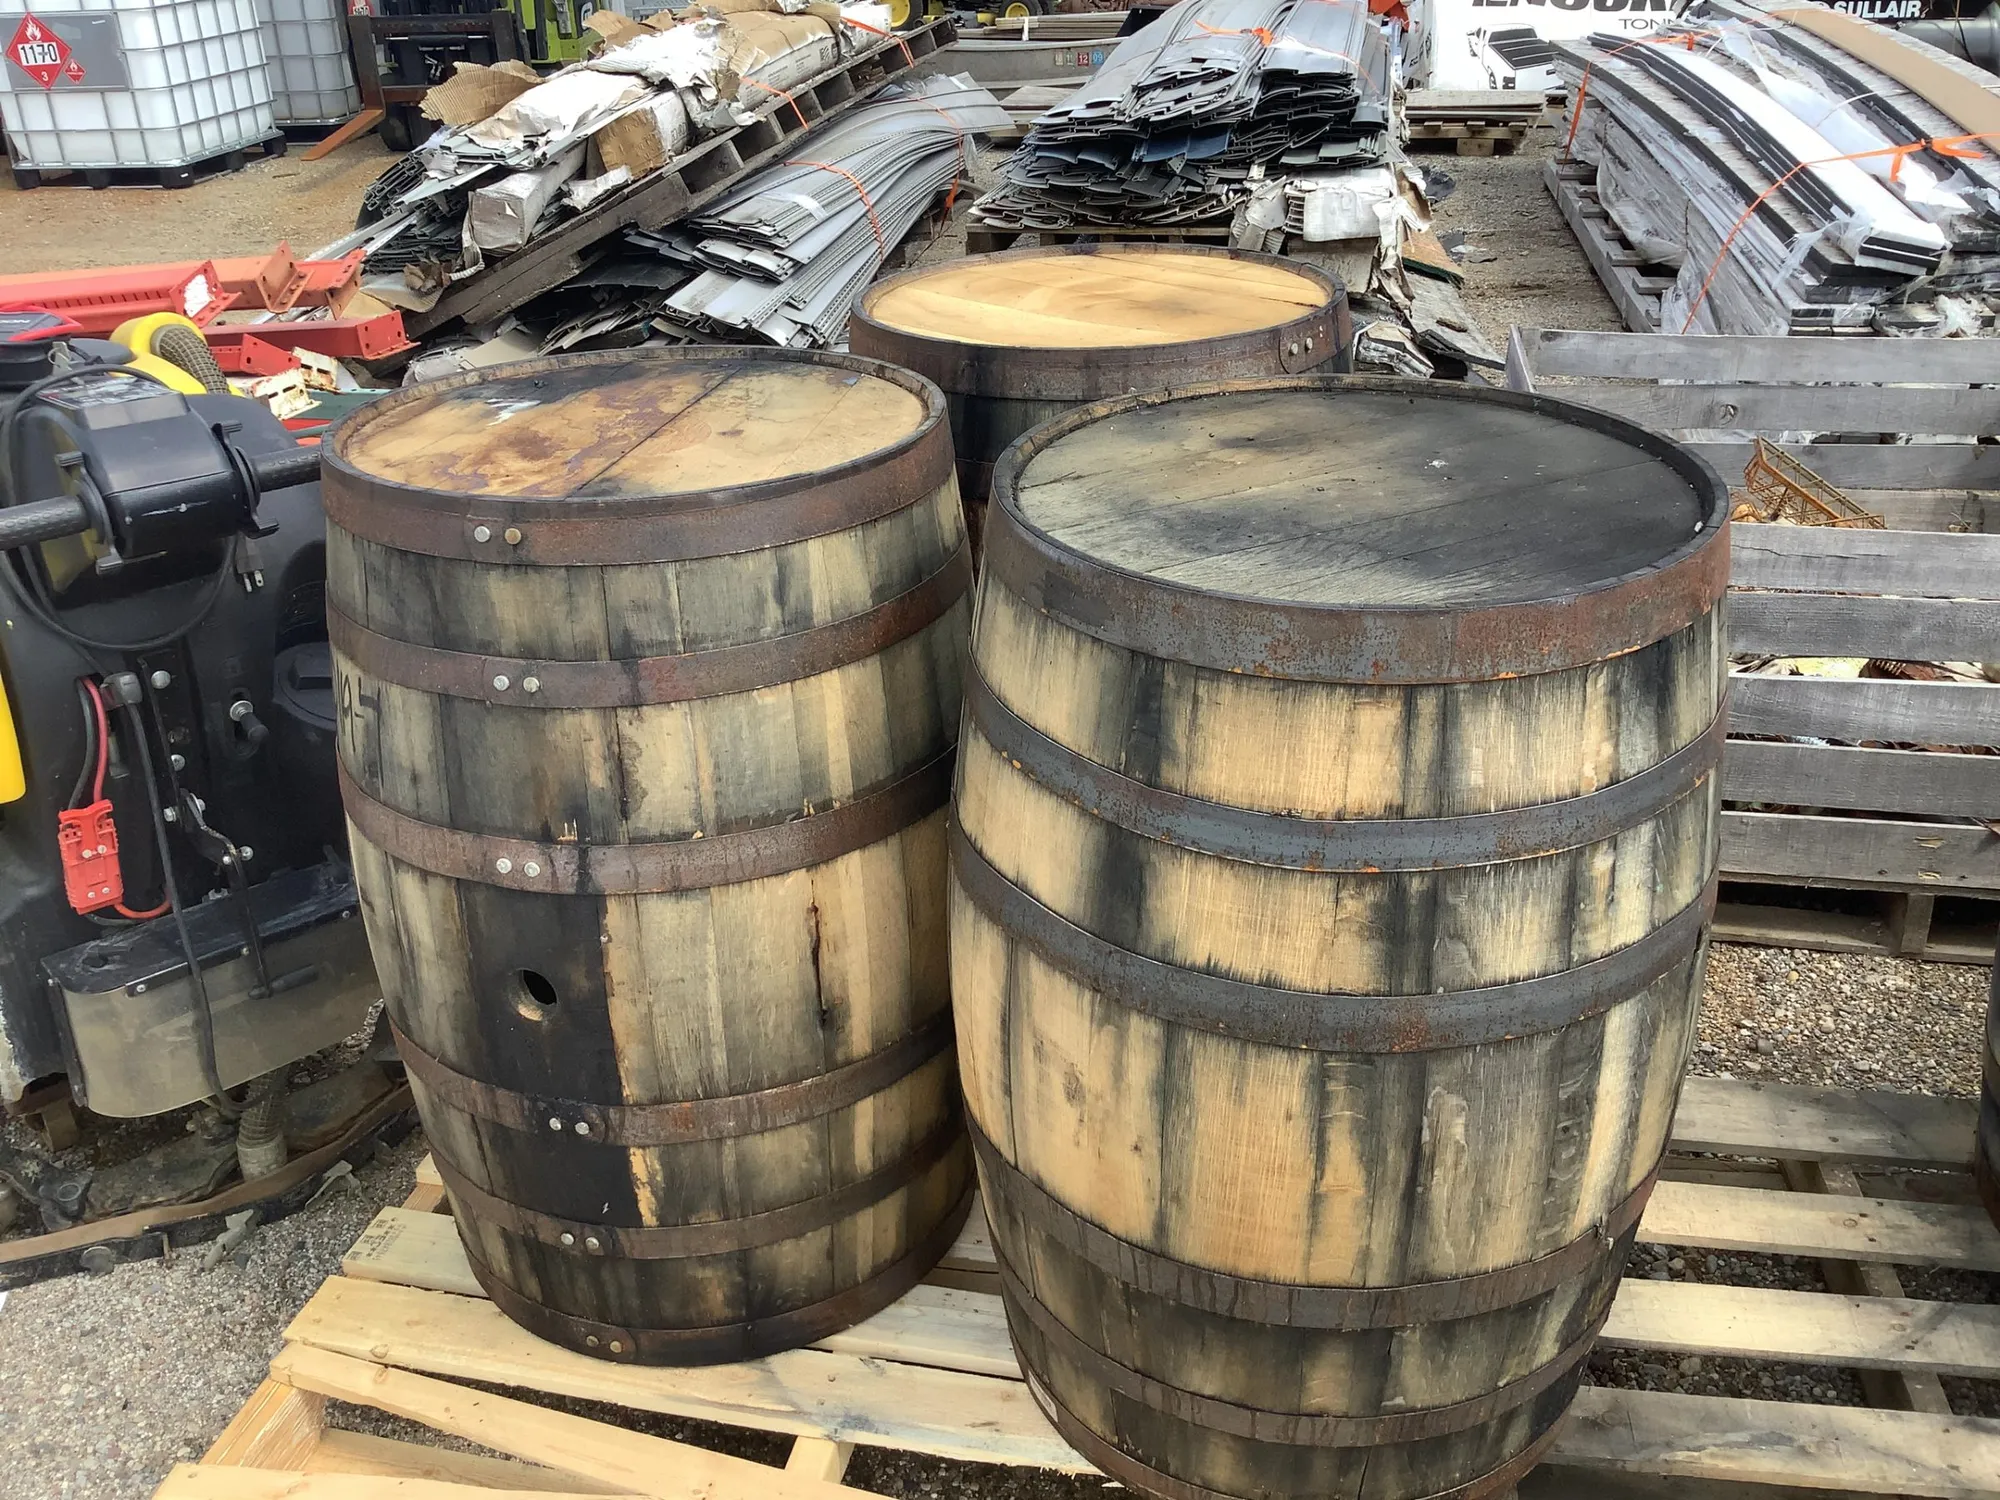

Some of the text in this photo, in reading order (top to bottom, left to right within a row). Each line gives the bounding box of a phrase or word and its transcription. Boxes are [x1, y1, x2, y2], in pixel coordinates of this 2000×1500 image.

[1834, 1, 1922, 19] SULLAIR
[20, 43, 58, 64] 1170
[1079, 54, 1088, 64] 12
[1092, 53, 1103, 62] 09
[41, 71, 48, 81] 3
